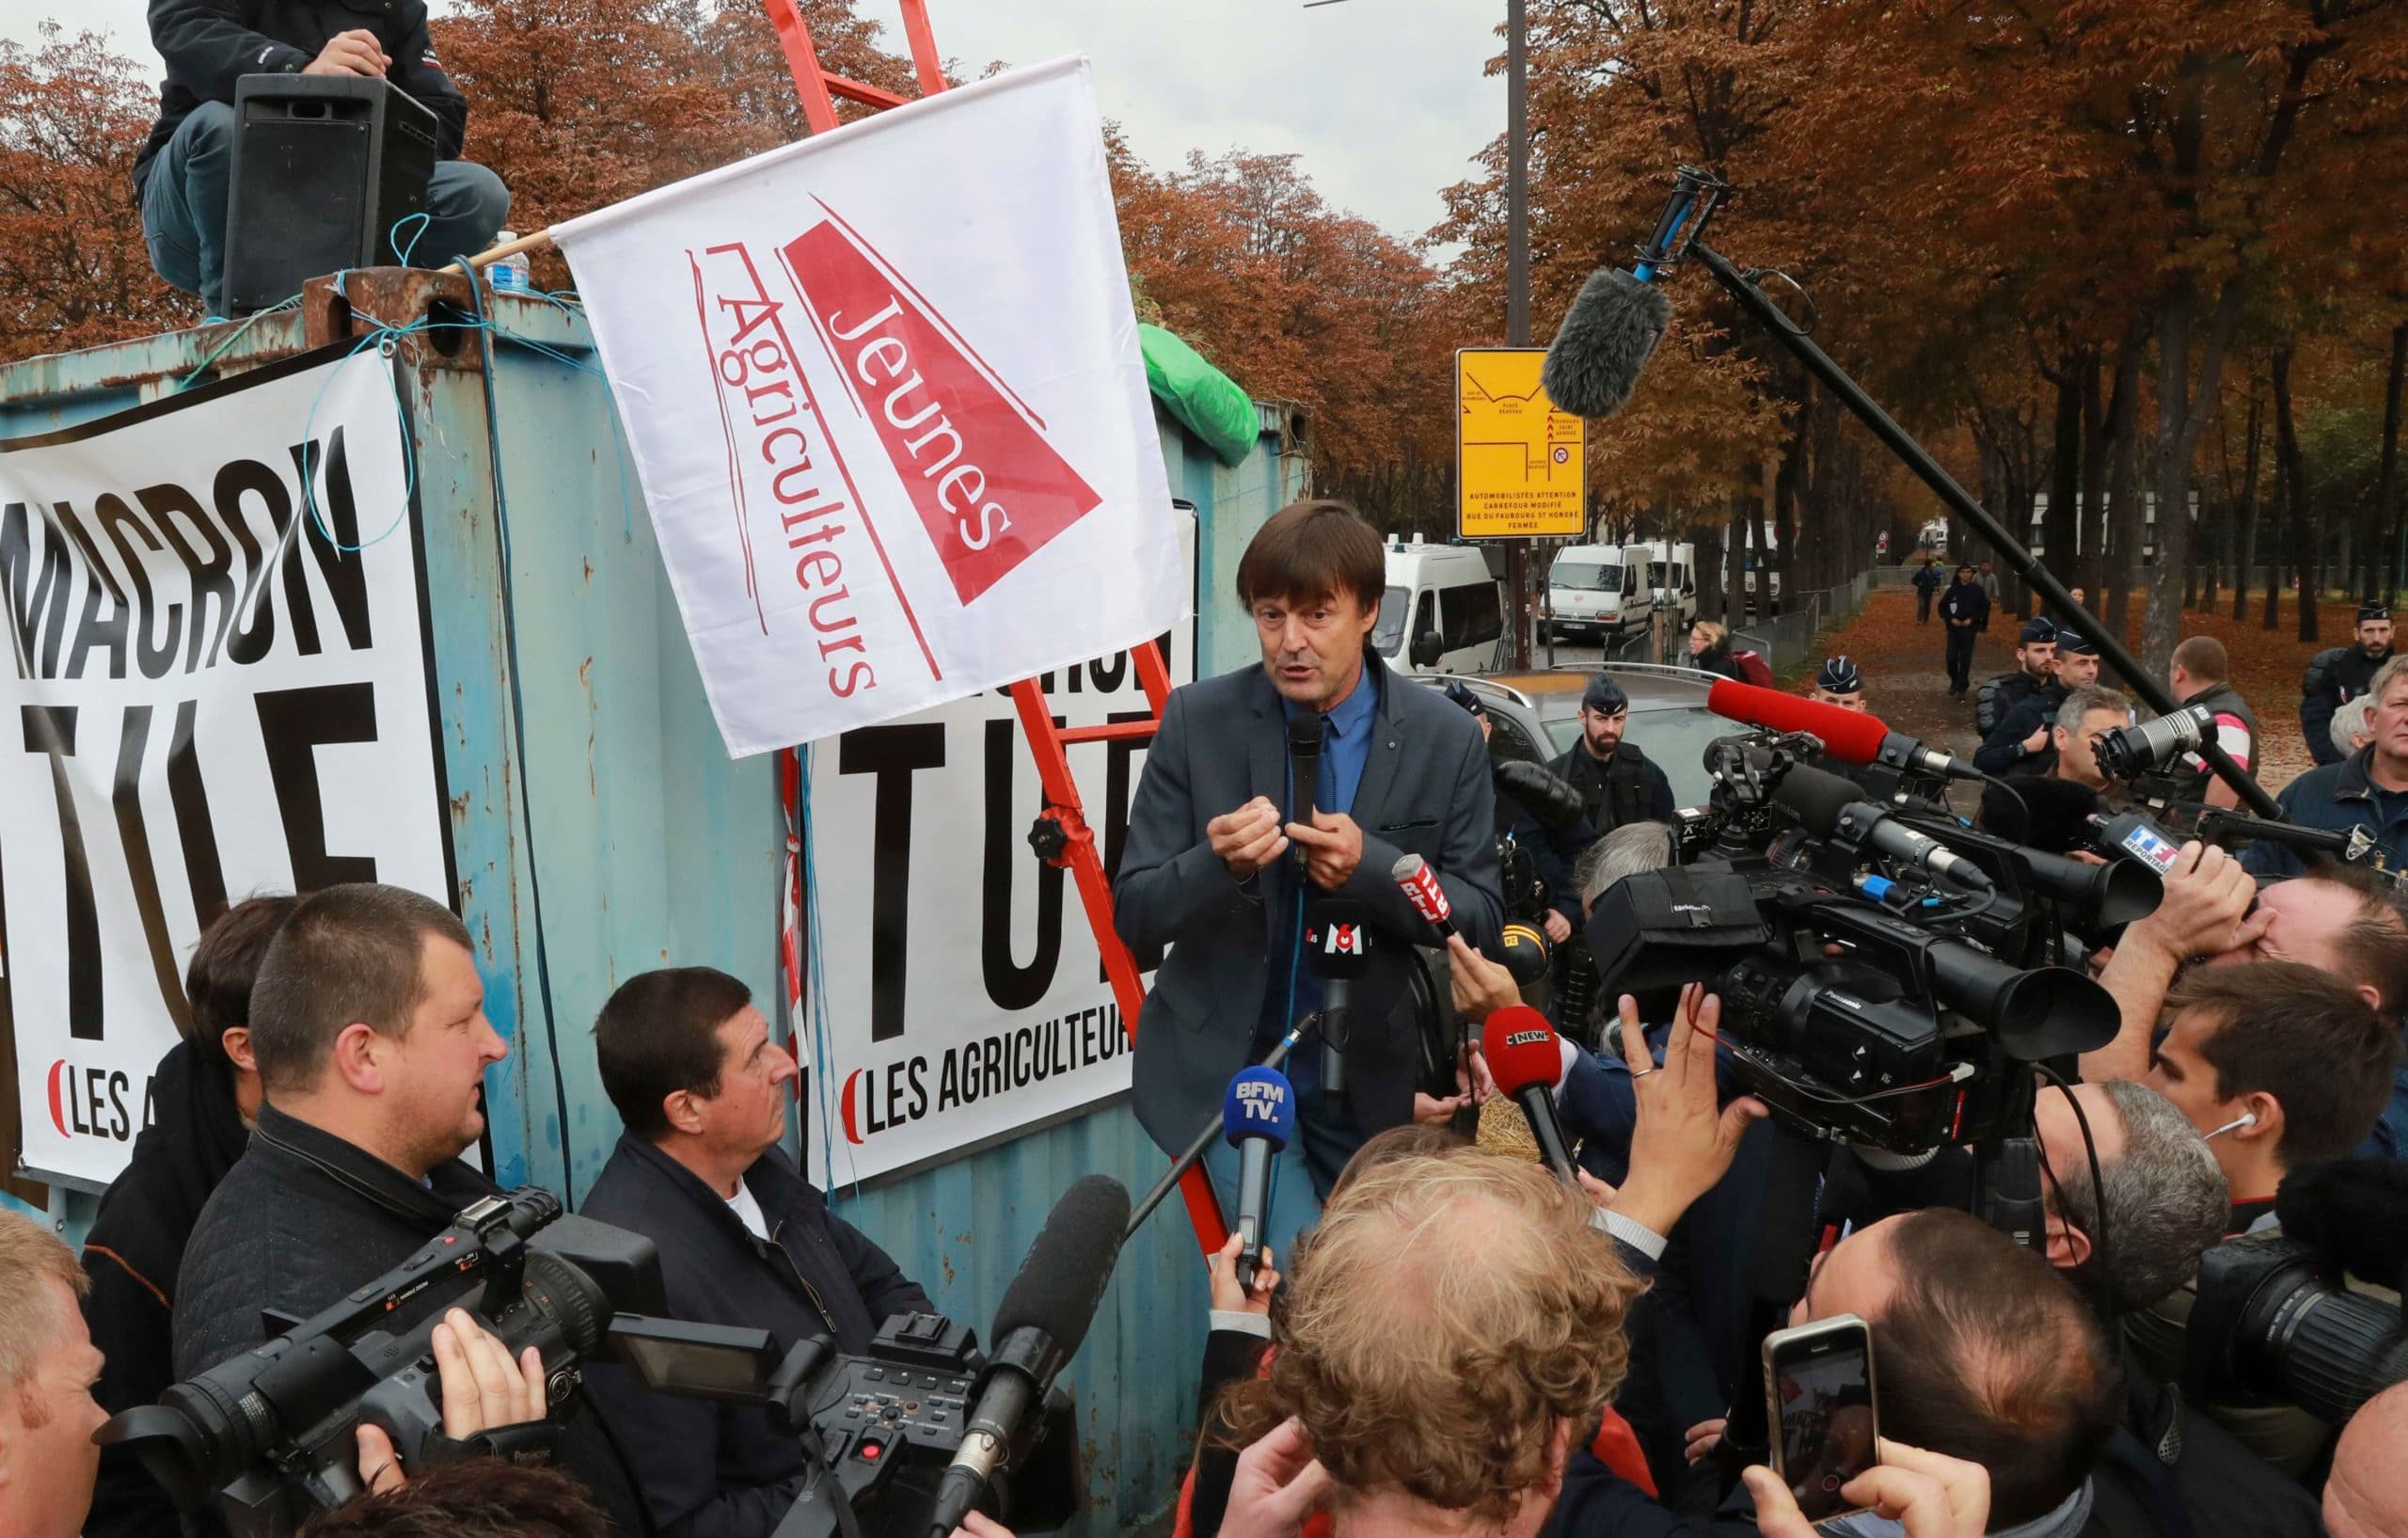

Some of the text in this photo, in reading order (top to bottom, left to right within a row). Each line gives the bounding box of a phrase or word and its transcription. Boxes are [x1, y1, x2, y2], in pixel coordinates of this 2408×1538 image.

[717, 293, 878, 699] Agriculteurs
[828, 293, 1013, 551] Jeunes
[0, 425, 373, 681] MACRON
[1401, 882, 1438, 920] RTL
[1236, 1082, 1284, 1103] BFM
